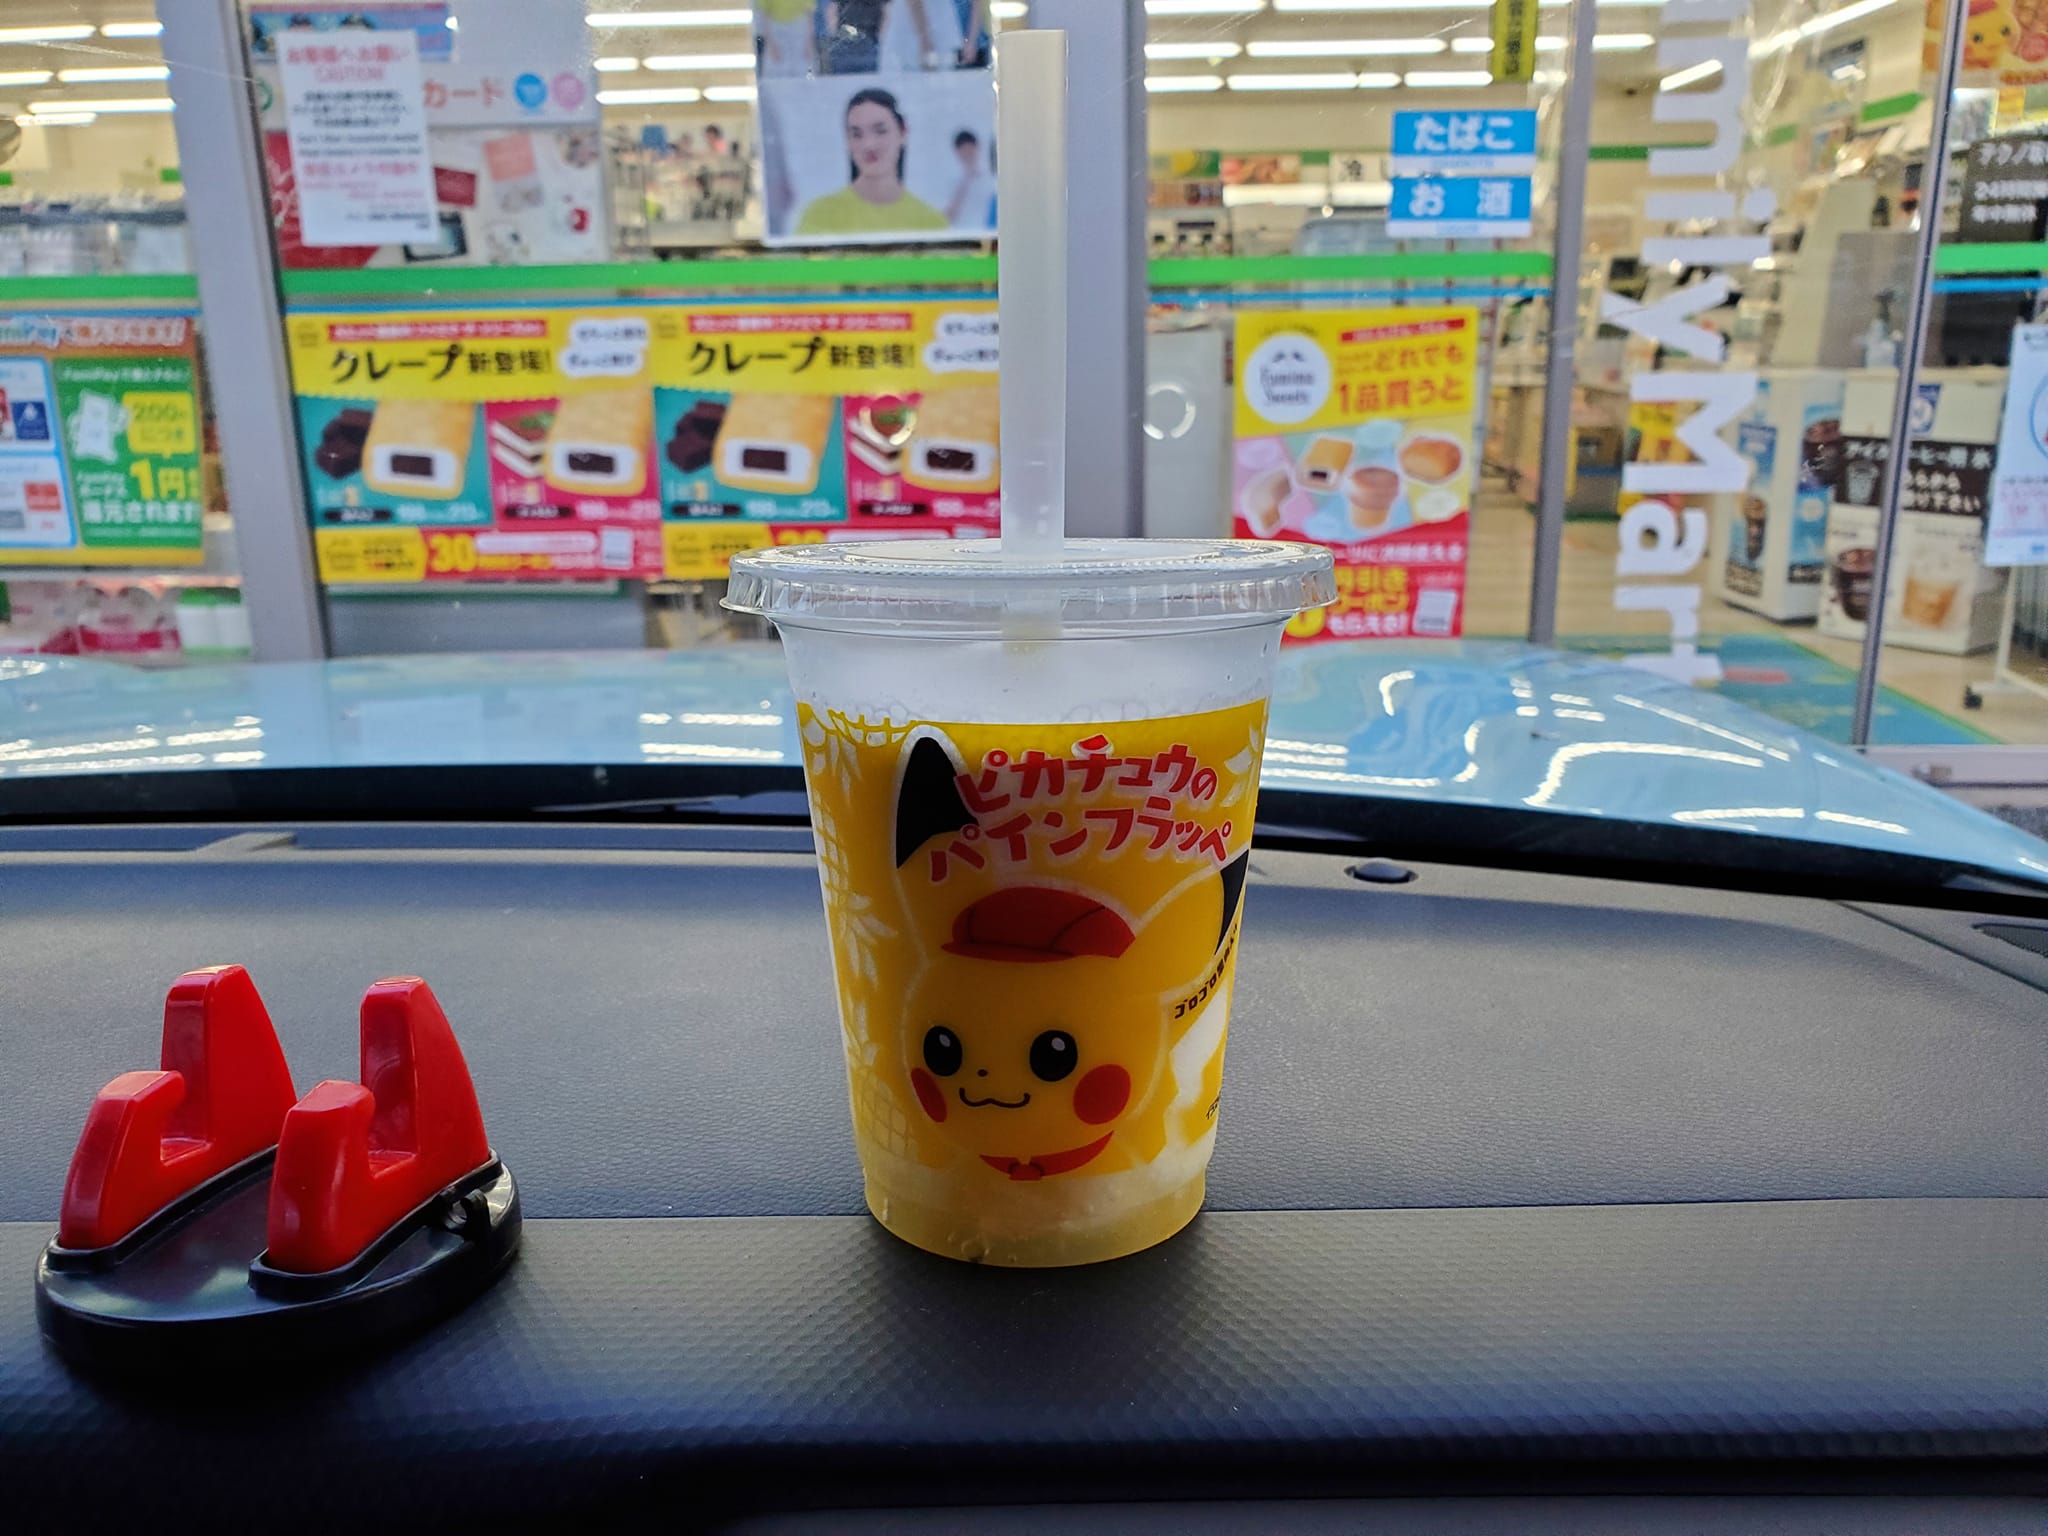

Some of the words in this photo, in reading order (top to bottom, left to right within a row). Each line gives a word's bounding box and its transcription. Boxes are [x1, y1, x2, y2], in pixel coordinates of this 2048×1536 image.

[1413, 115, 1515, 151] たばこ
[1339, 375, 1466, 415] 1品買うと
[430, 532, 478, 573] 30
[955, 733, 1218, 814] ピカチュウの
[930, 795, 1232, 883] パインフラッペ
